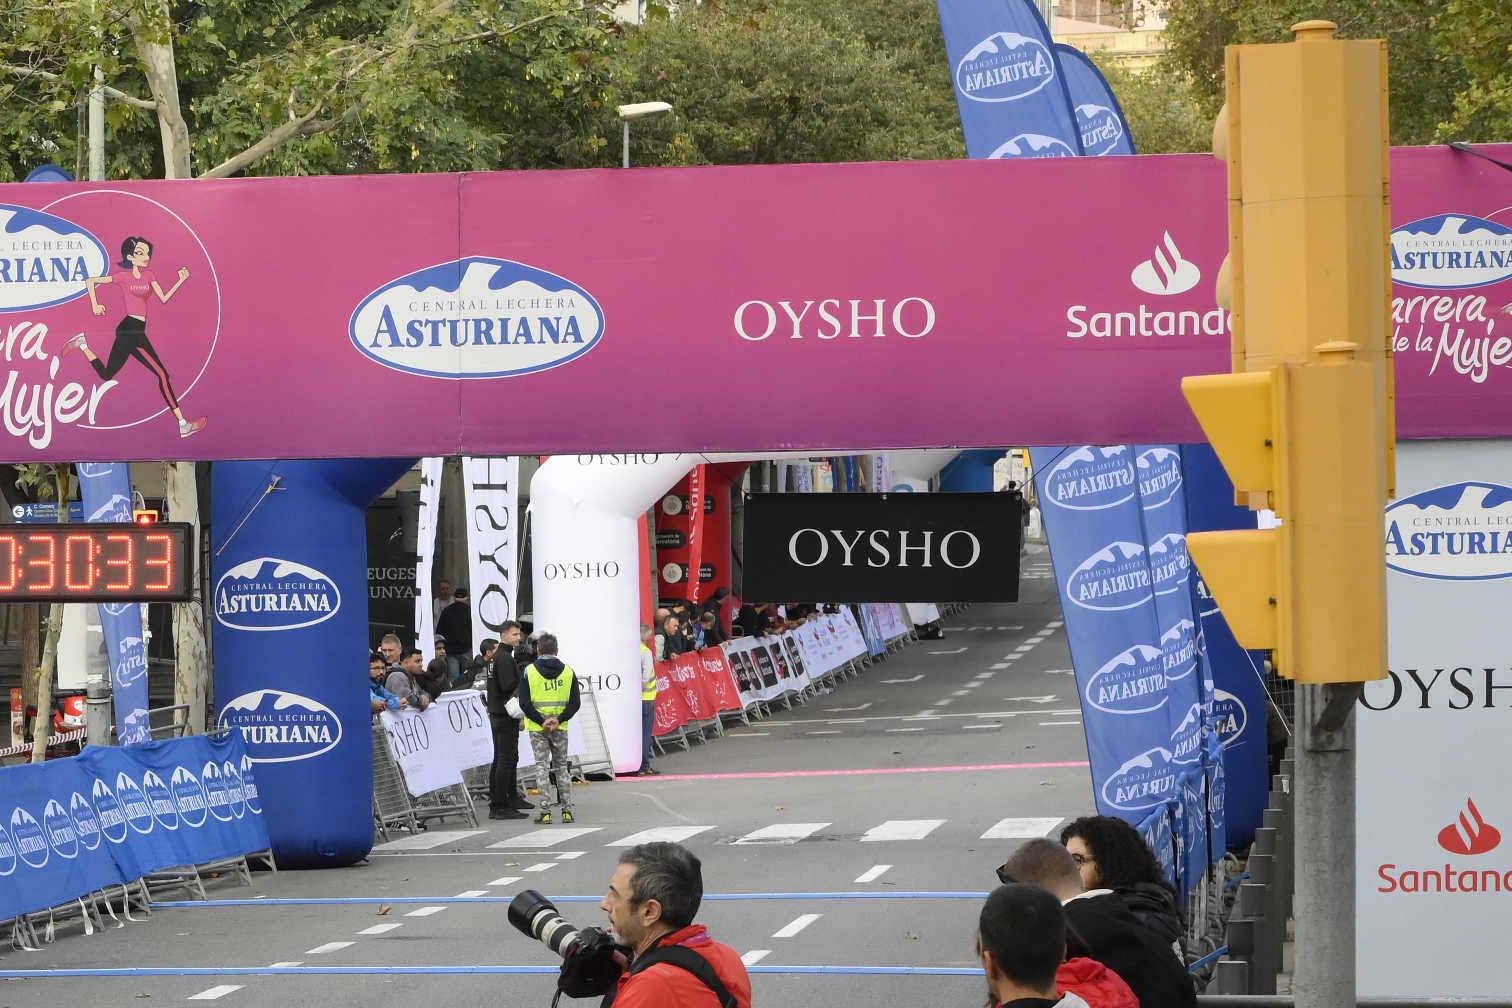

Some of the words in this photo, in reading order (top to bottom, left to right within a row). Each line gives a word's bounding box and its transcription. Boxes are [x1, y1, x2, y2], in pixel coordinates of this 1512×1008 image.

[12, 240, 85, 253] LECHERA
[1406, 238, 1457, 248] CENTRAL
[408, 299, 488, 313] CENTRAL
[496, 296, 576, 311] LECHERA
[1391, 294, 1487, 324] arrera
[368, 304, 585, 349] ASTURIANA
[732, 296, 937, 342] OYSHO
[1066, 304, 1233, 339] Santand
[1415, 325, 1433, 353] la
[1429, 318, 1512, 384] Muje
[1413, 516, 1480, 527] CENTRAL
[788, 527, 982, 570] OYSHO
[544, 560, 620, 581] OYSHO
[230, 582, 273, 592] CENTRAL
[278, 582, 326, 592] LECHERA
[218, 587, 331, 615] ASTURIANA
[544, 678, 564, 692] Life
[577, 673, 622, 692] SHO
[1357, 667, 1512, 712] OYSH
[232, 714, 274, 723] CENTRAL
[278, 713, 327, 723] LECHERA
[1377, 864, 1512, 893] Santan
